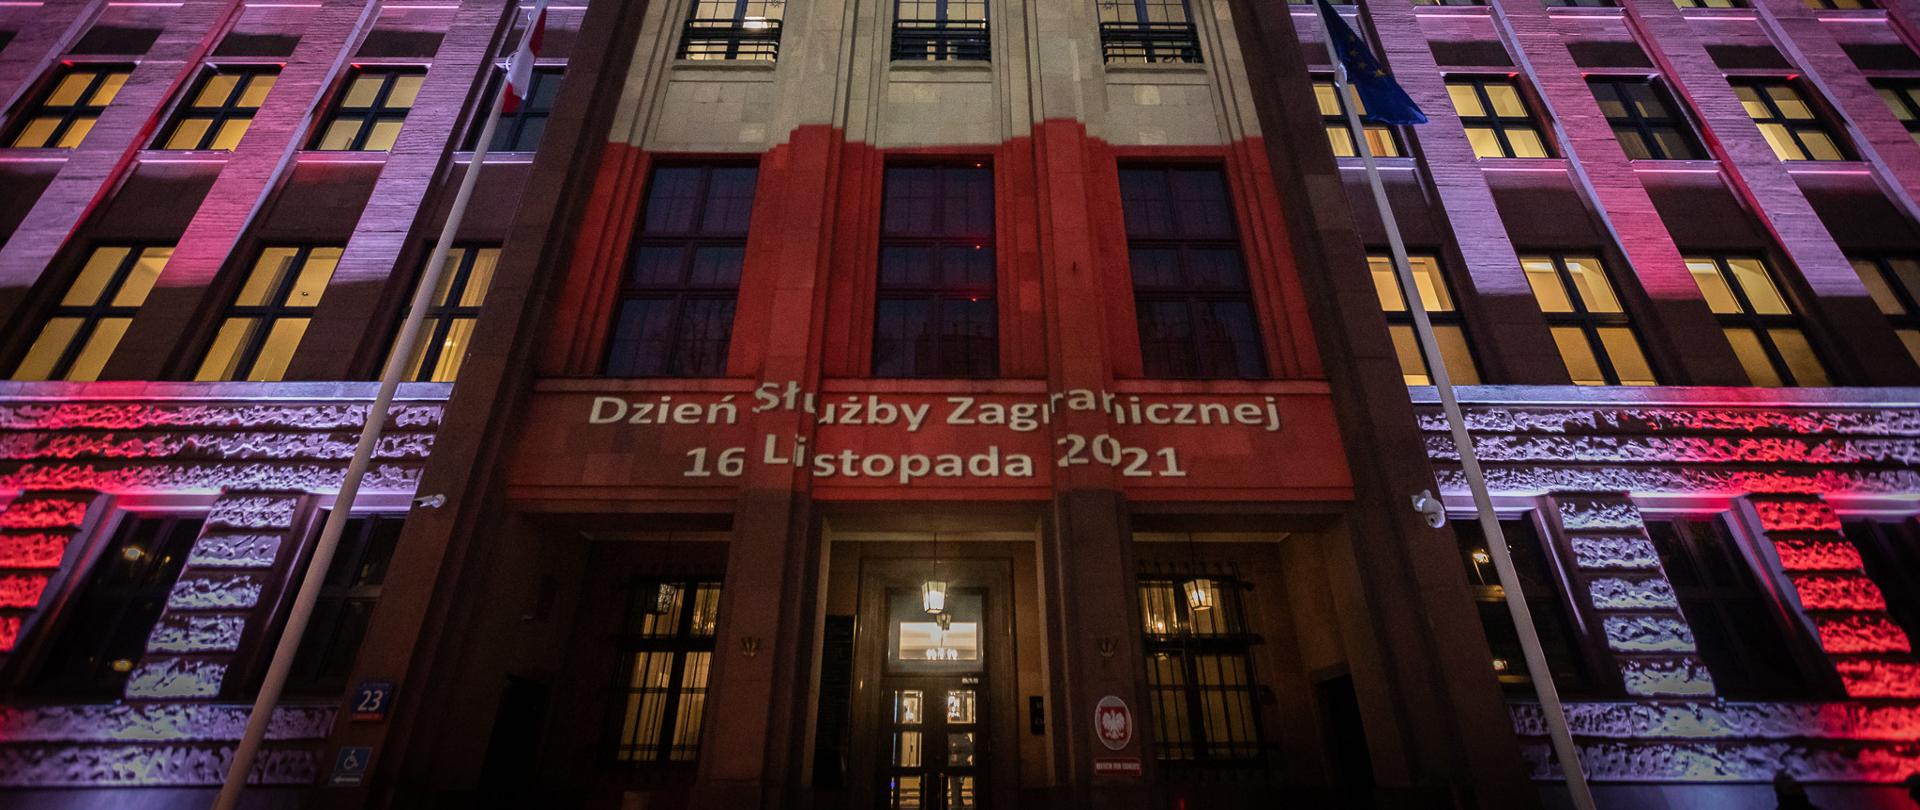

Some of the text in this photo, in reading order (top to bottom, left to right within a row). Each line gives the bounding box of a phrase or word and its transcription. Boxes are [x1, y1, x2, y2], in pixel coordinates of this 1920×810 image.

[589, 380, 1281, 431] Dzień Służby Zagranicznej
[684, 433, 1186, 484] 16 Listopada 2021
[357, 690, 384, 712] 23
